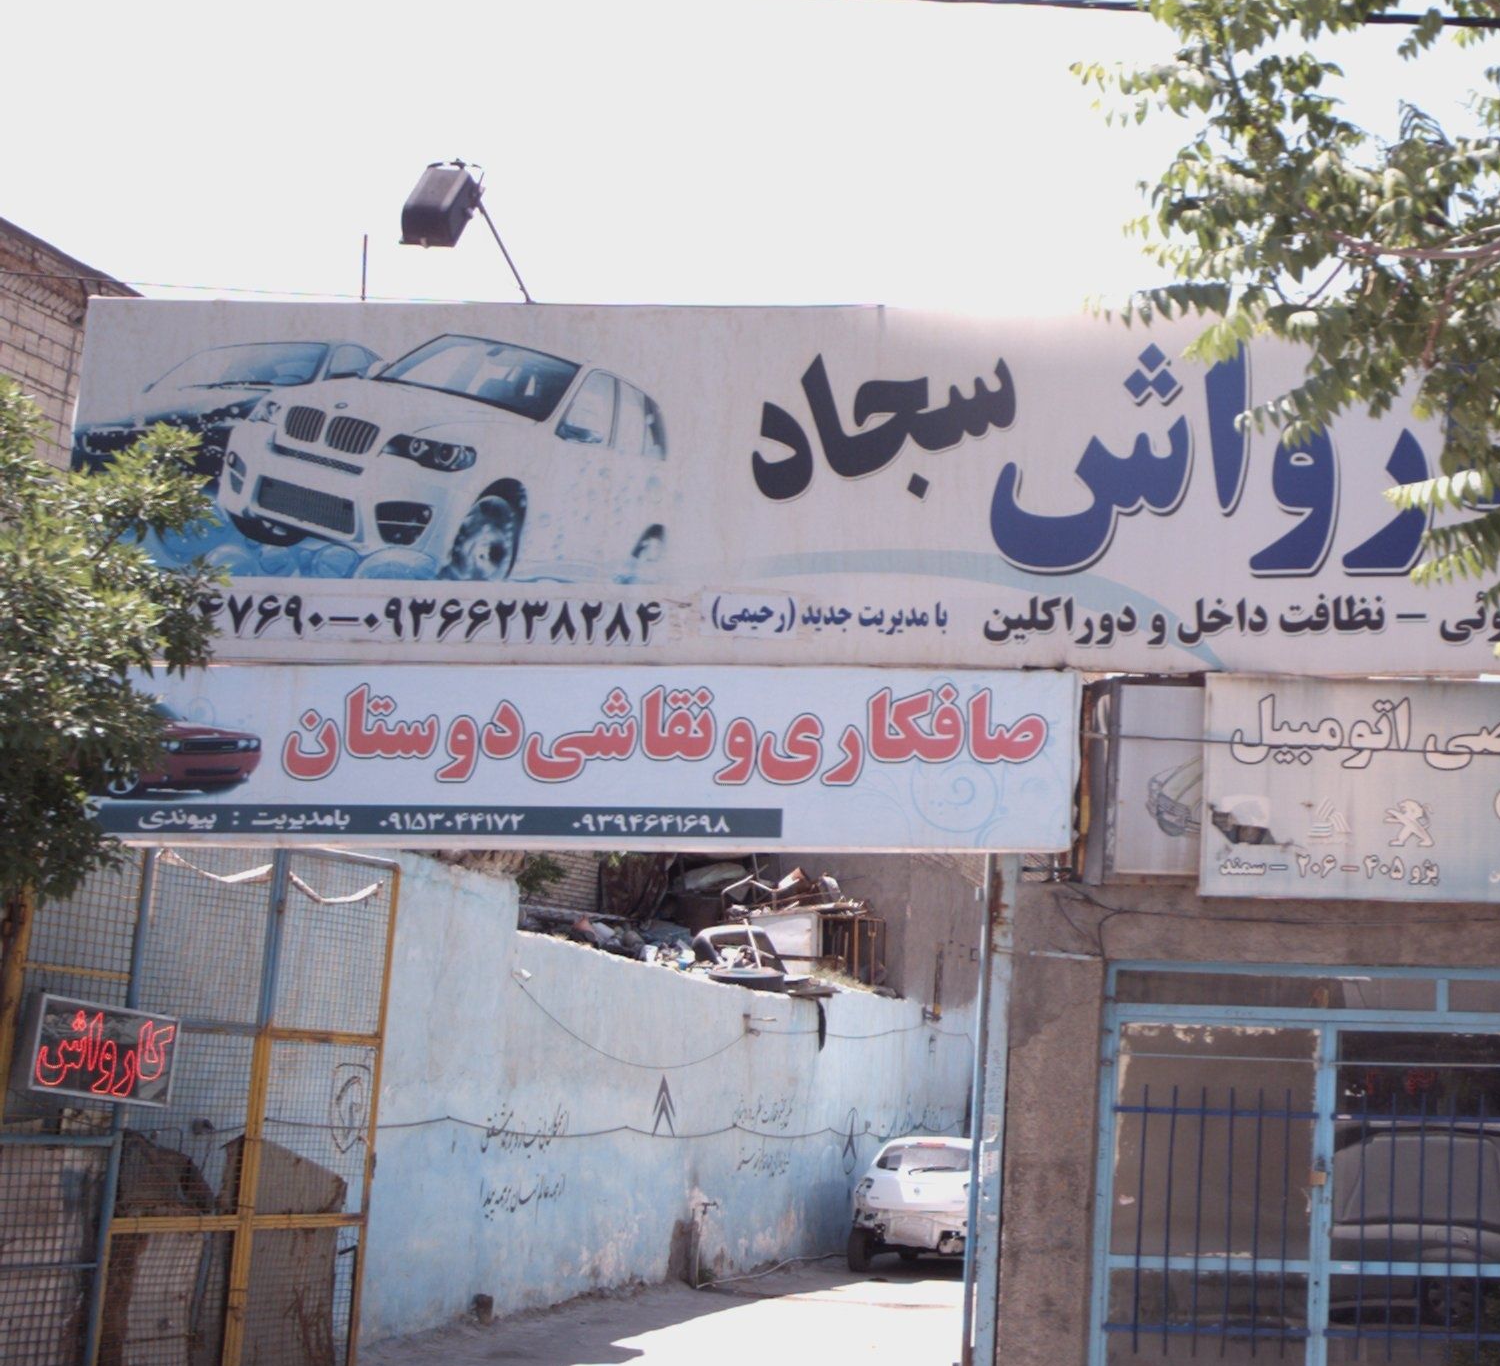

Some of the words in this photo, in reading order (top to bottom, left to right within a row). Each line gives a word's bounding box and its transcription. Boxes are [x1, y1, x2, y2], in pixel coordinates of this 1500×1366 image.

[752, 351, 1018, 503] سجاد
[711, 595, 796, 634] (رحیمی)
[801, 605, 853, 635] جدید
[858, 604, 931, 636] مدیریت
[934, 601, 949, 630] با
[1147, 605, 1168, 646] و
[1177, 595, 1269, 645] داخل
[1279, 591, 1387, 635] نظافت
[282, 681, 526, 784] دوستان
[523, 681, 719, 785] نقاشی
[713, 715, 757, 787] و
[757, 681, 1050, 787] صافکاری
[1230, 693, 1413, 770] اتومبیل
[137, 810, 218, 832] پیوندی
[1218, 859, 1267, 878] سمند
[1296, 853, 1339, 880] ۲۰۶
[1362, 854, 1406, 881] ۴۰۵
[1409, 859, 1441, 887] پژو
[34, 1009, 176, 1098] کارواش
